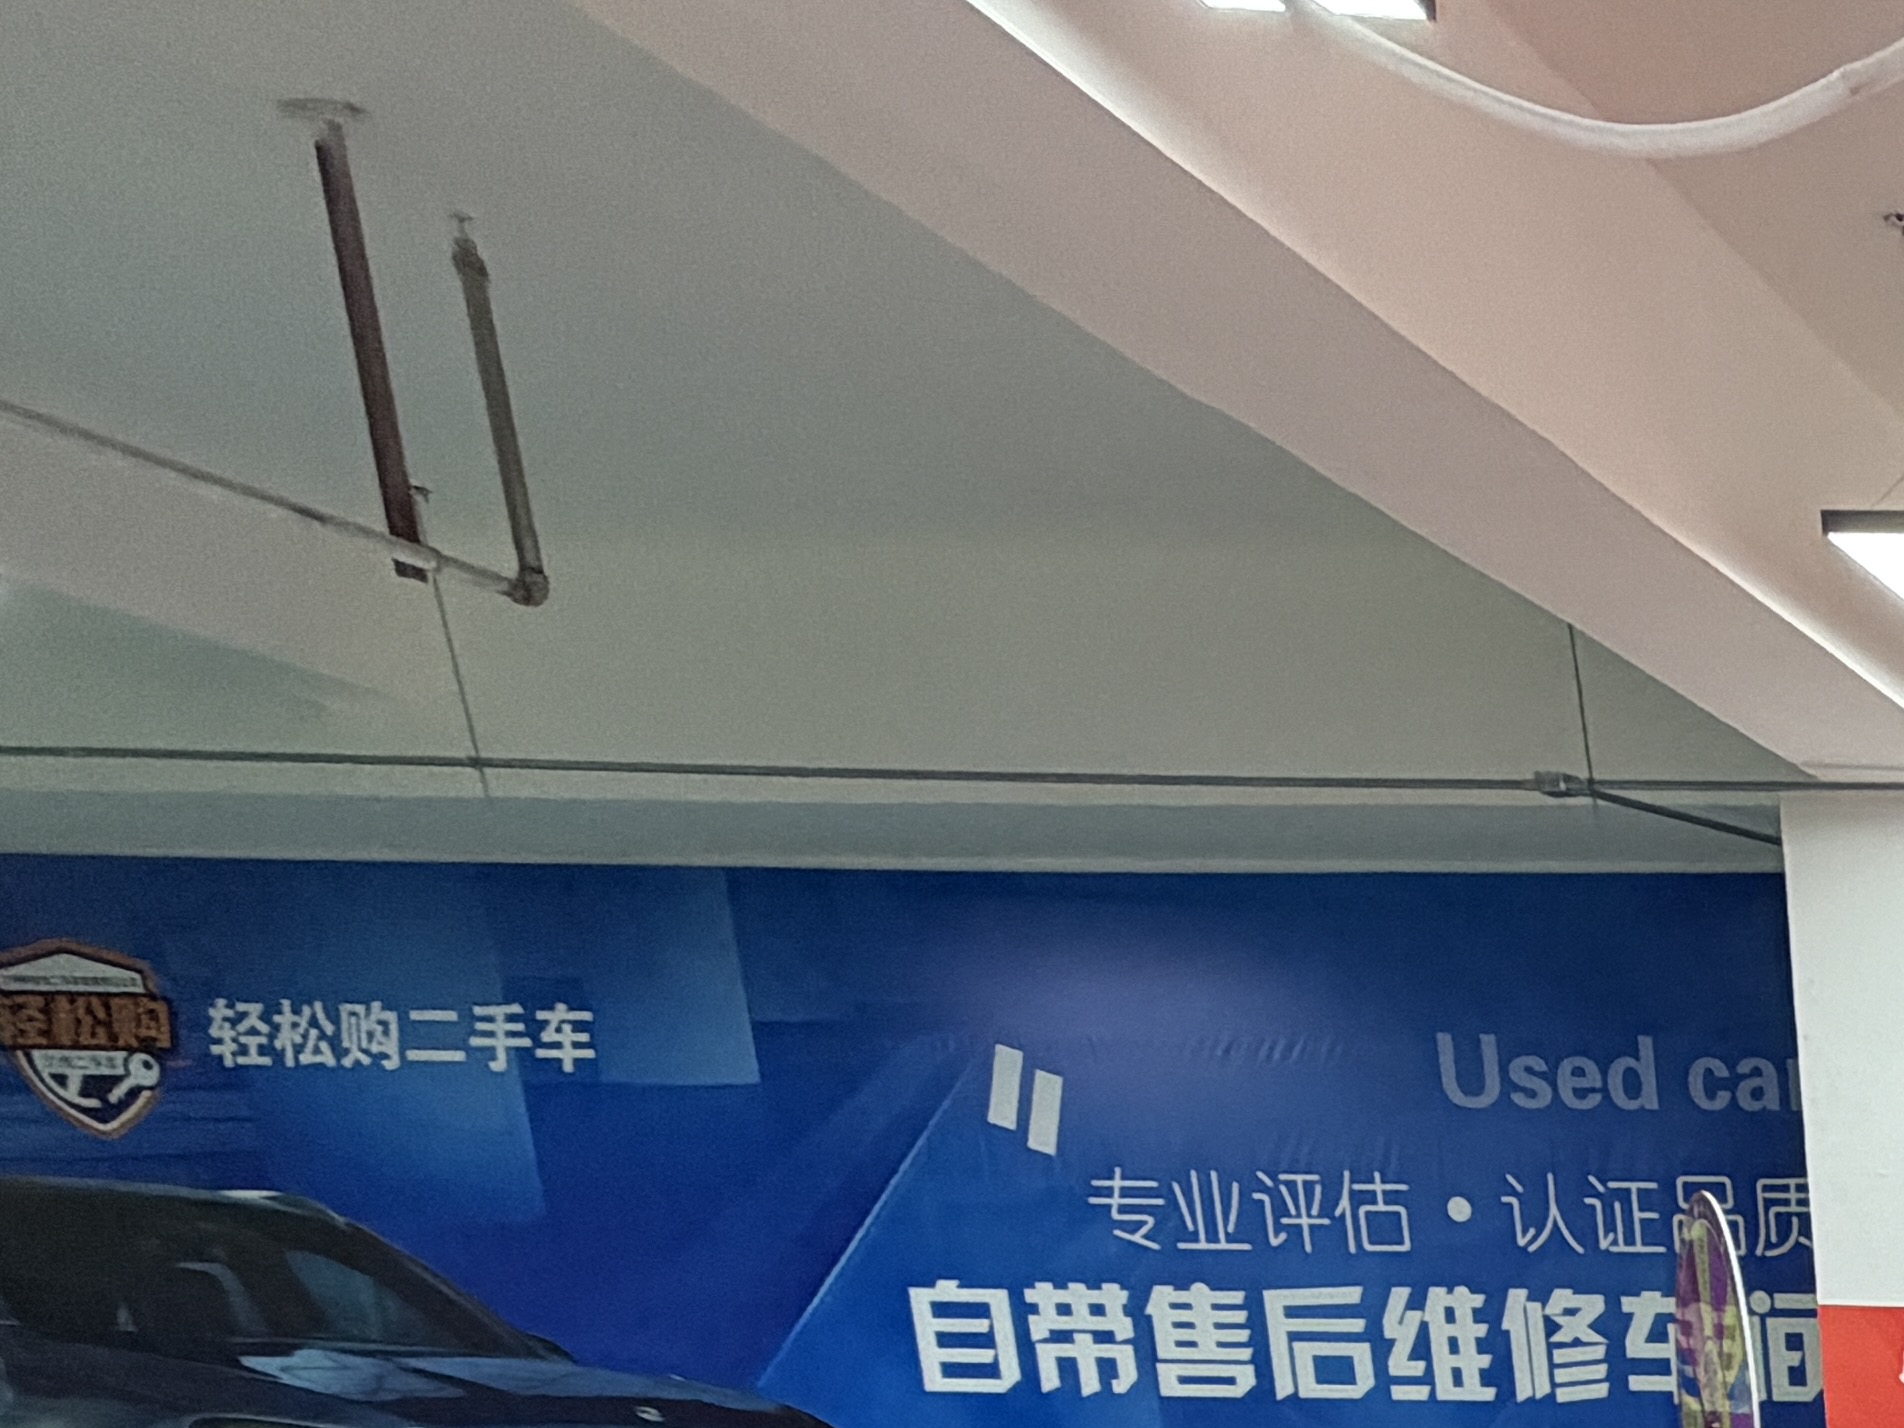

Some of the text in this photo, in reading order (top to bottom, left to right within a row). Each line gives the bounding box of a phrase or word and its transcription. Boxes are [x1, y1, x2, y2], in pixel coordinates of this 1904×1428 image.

[207, 997, 597, 1074] 轻松购二手车
[1436, 1031, 1660, 1111] Used
